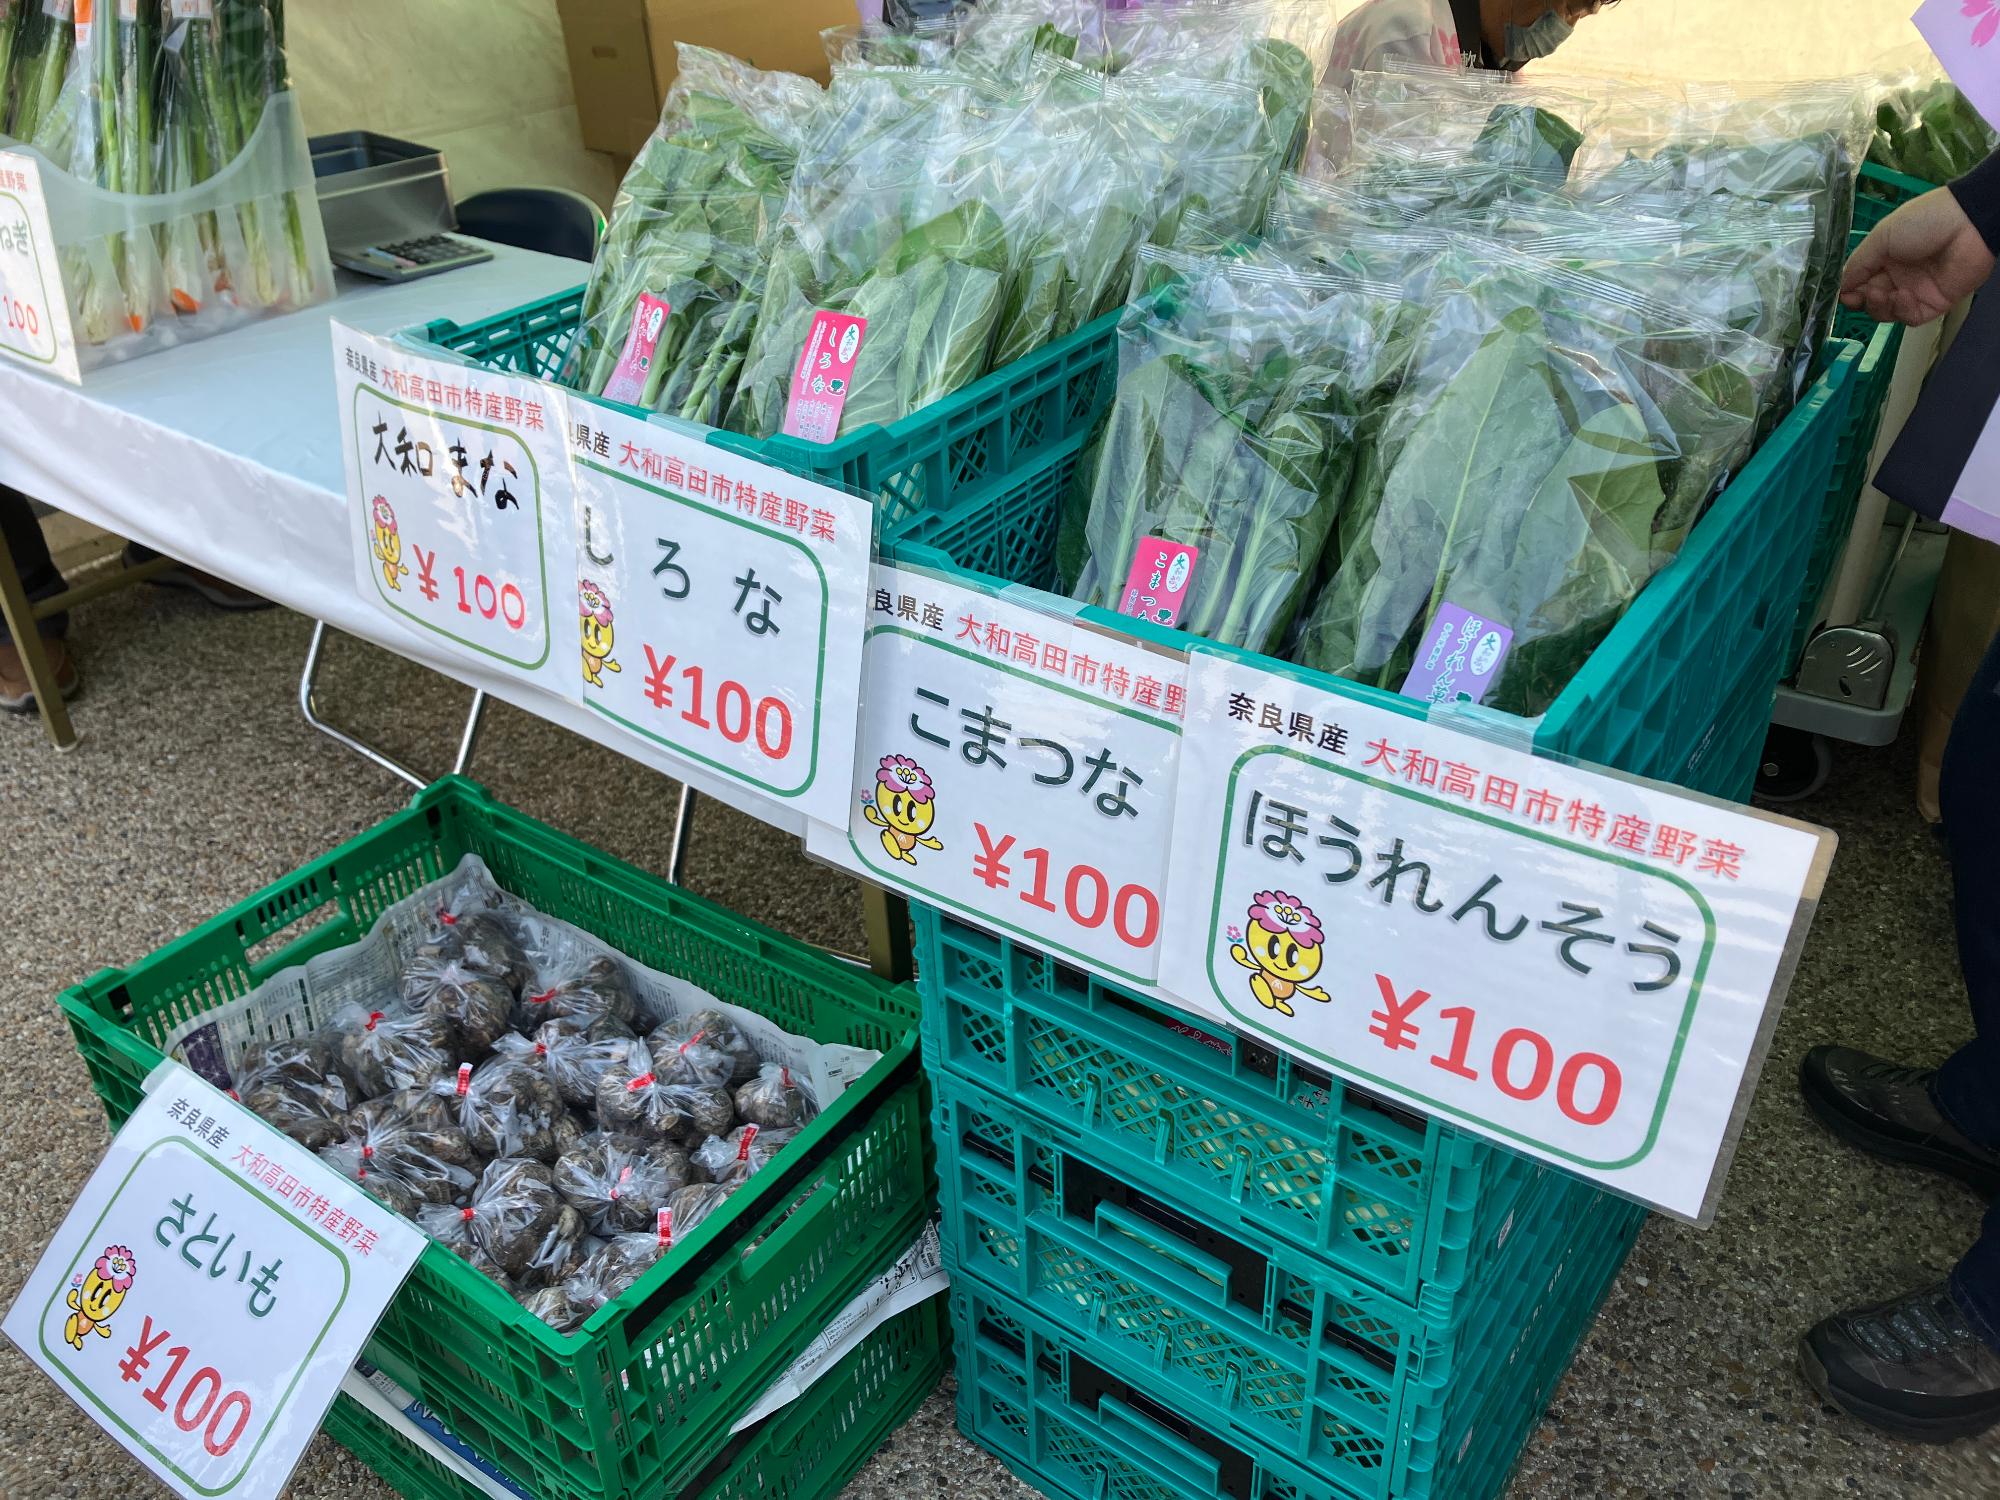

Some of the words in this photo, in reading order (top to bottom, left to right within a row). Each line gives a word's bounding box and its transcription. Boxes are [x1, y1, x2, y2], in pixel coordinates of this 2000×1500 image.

[345, 347, 378, 383] 奈良県産
[381, 366, 545, 432] 大和高田市特産野菜
[811, 327, 837, 394] しろな
[371, 409, 520, 511] 大和まな
[568, 421, 611, 459] 県産
[618, 440, 837, 543] 大和高田市特産野菜
[412, 544, 525, 629] ¥100
[642, 644, 794, 761] ¥100
[909, 685, 1145, 819] こまつな
[1227, 692, 1350, 755] 奈良県産
[1361, 737, 1746, 880] 大和高田市特産野菜
[972, 821, 1161, 949] ¥100
[1241, 789, 1682, 994] ほうれんそう
[1368, 972, 1623, 1126] ¥100
[166, 1098, 230, 1149] 奈良県産
[231, 1144, 380, 1256] 大和高田市特産野菜
[154, 1193, 284, 1318] さといも
[118, 1315, 252, 1457] ¥100
